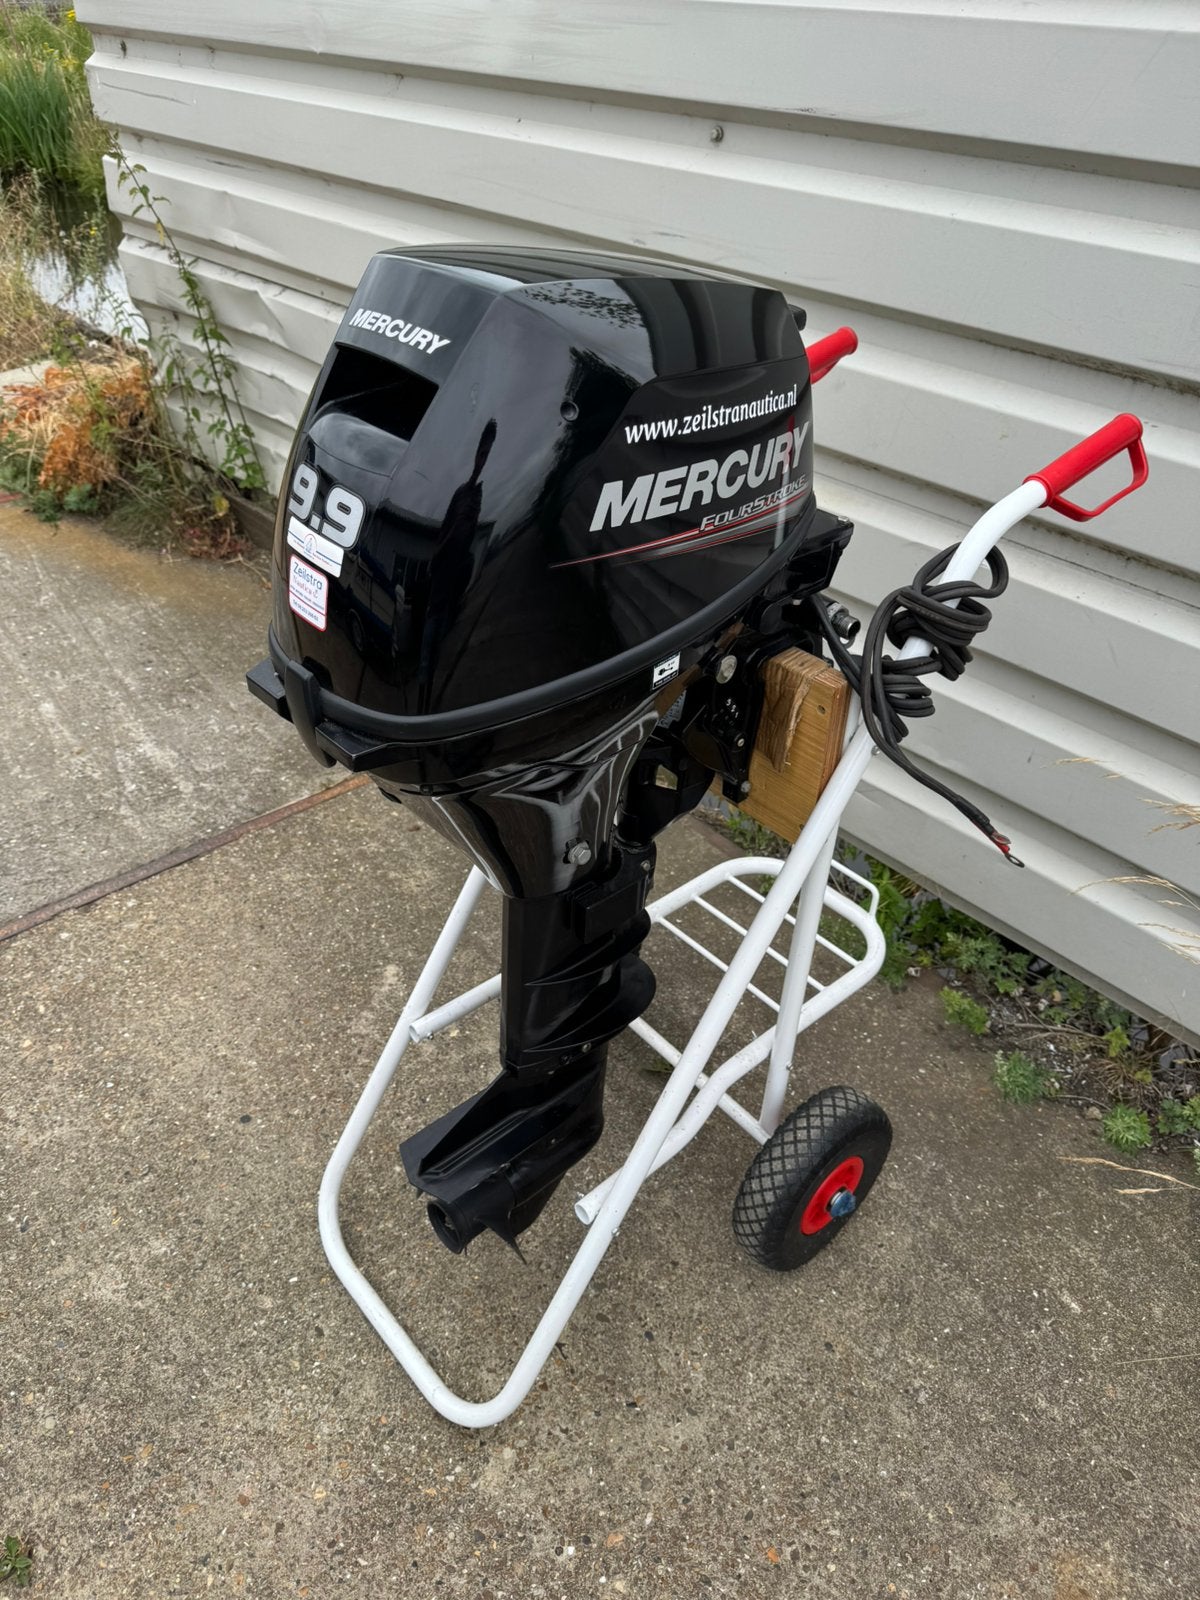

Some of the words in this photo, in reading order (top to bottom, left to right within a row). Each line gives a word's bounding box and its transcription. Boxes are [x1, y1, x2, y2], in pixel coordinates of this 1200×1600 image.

[348, 308, 451, 355] MERCURY
[624, 384, 798, 445] www.zeilstranautica.nl
[288, 463, 365, 549] 9.9
[589, 420, 810, 533] MERCURY
[699, 474, 810, 531] FOURSTROKE
[293, 561, 323, 591] Zeilstra
